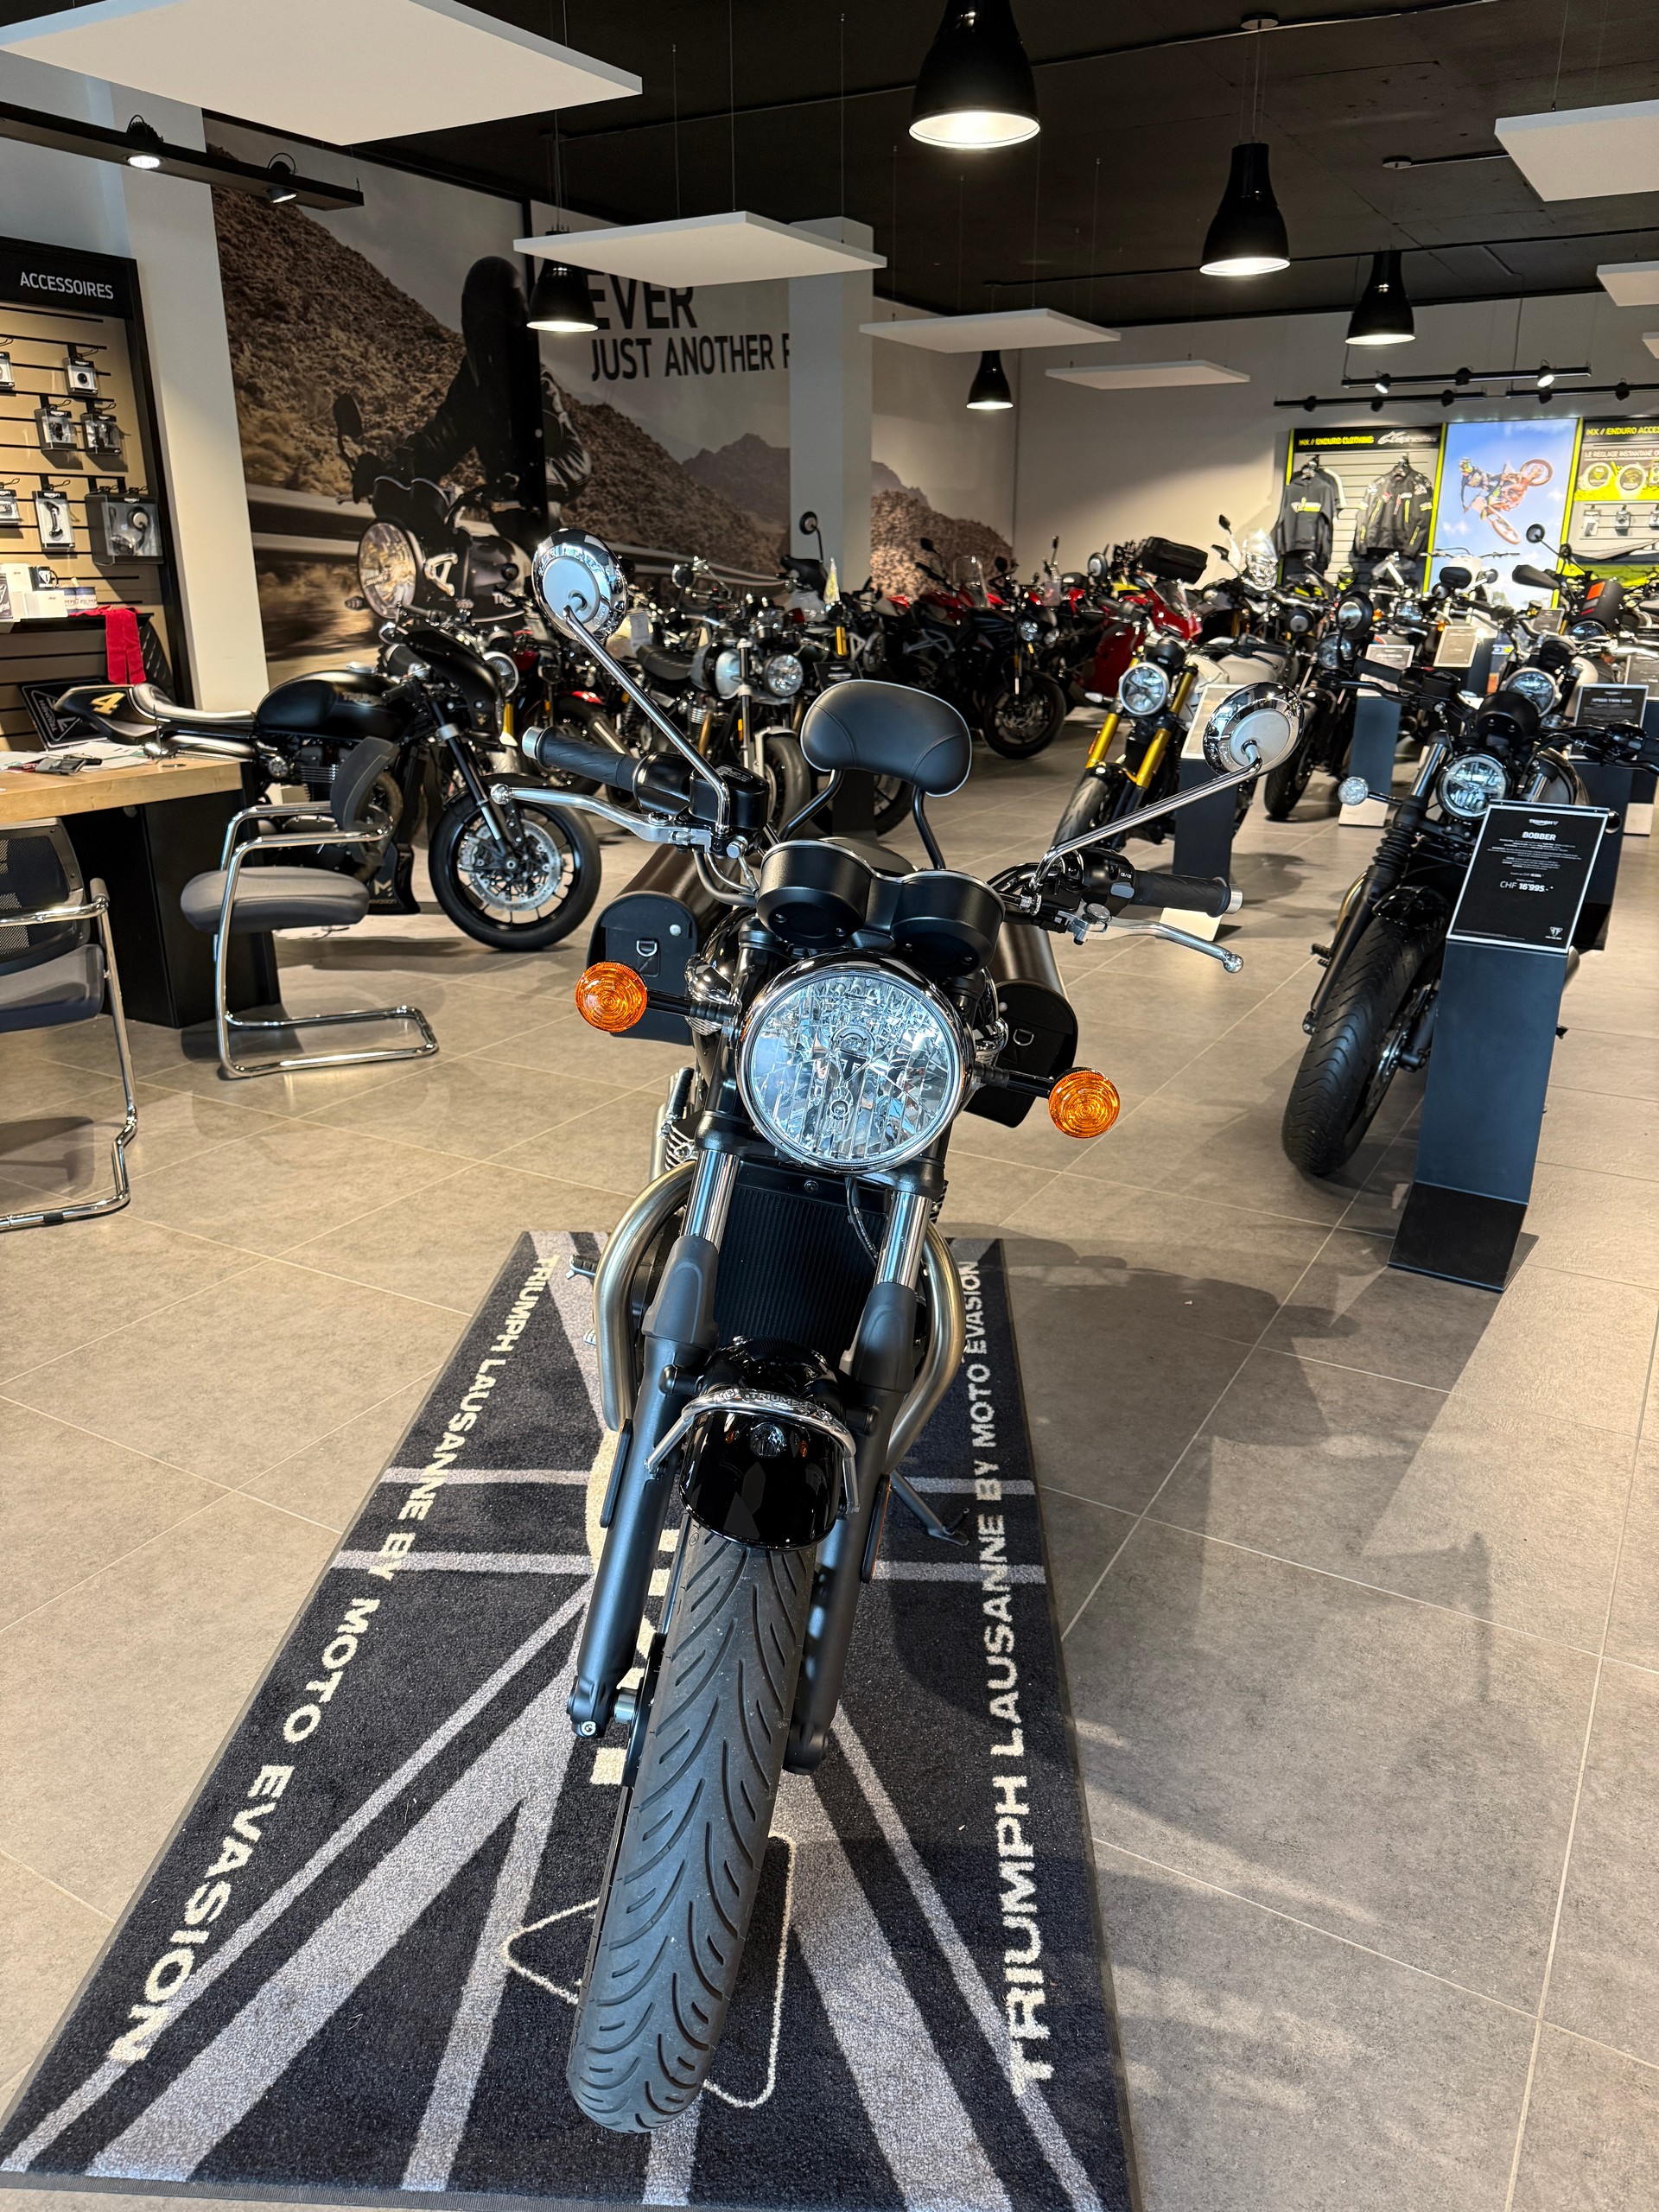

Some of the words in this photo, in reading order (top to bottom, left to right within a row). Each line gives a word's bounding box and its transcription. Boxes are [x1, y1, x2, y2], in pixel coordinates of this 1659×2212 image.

[20, 271, 114, 300] ACCESSOIRES
[591, 338, 652, 382] JUST
[664, 334, 775, 378] ANOTHER
[1315, 437, 1342, 446] ENDURO
[1342, 435, 1374, 445] CLOTHING
[1605, 427, 1637, 435] ENDURO
[90, 692, 125, 715] 4
[1522, 831, 1556, 841] BOBBER
[1499, 880, 1517, 889] CHF
[490, 1255, 560, 1351] TRIUMPH
[958, 1261, 988, 1354] EVASION
[967, 1363, 997, 1447] MOTO
[397, 1359, 506, 1521] LAUSANNE
[975, 1459, 1003, 1502] BY
[368, 1532, 416, 1581] BY
[977, 1514, 1025, 1758] LAUSANNE
[283, 1599, 380, 1744] MOTO
[107, 1764, 295, 2063] EVASION
[993, 1775, 1056, 2097] TRIUMPH
